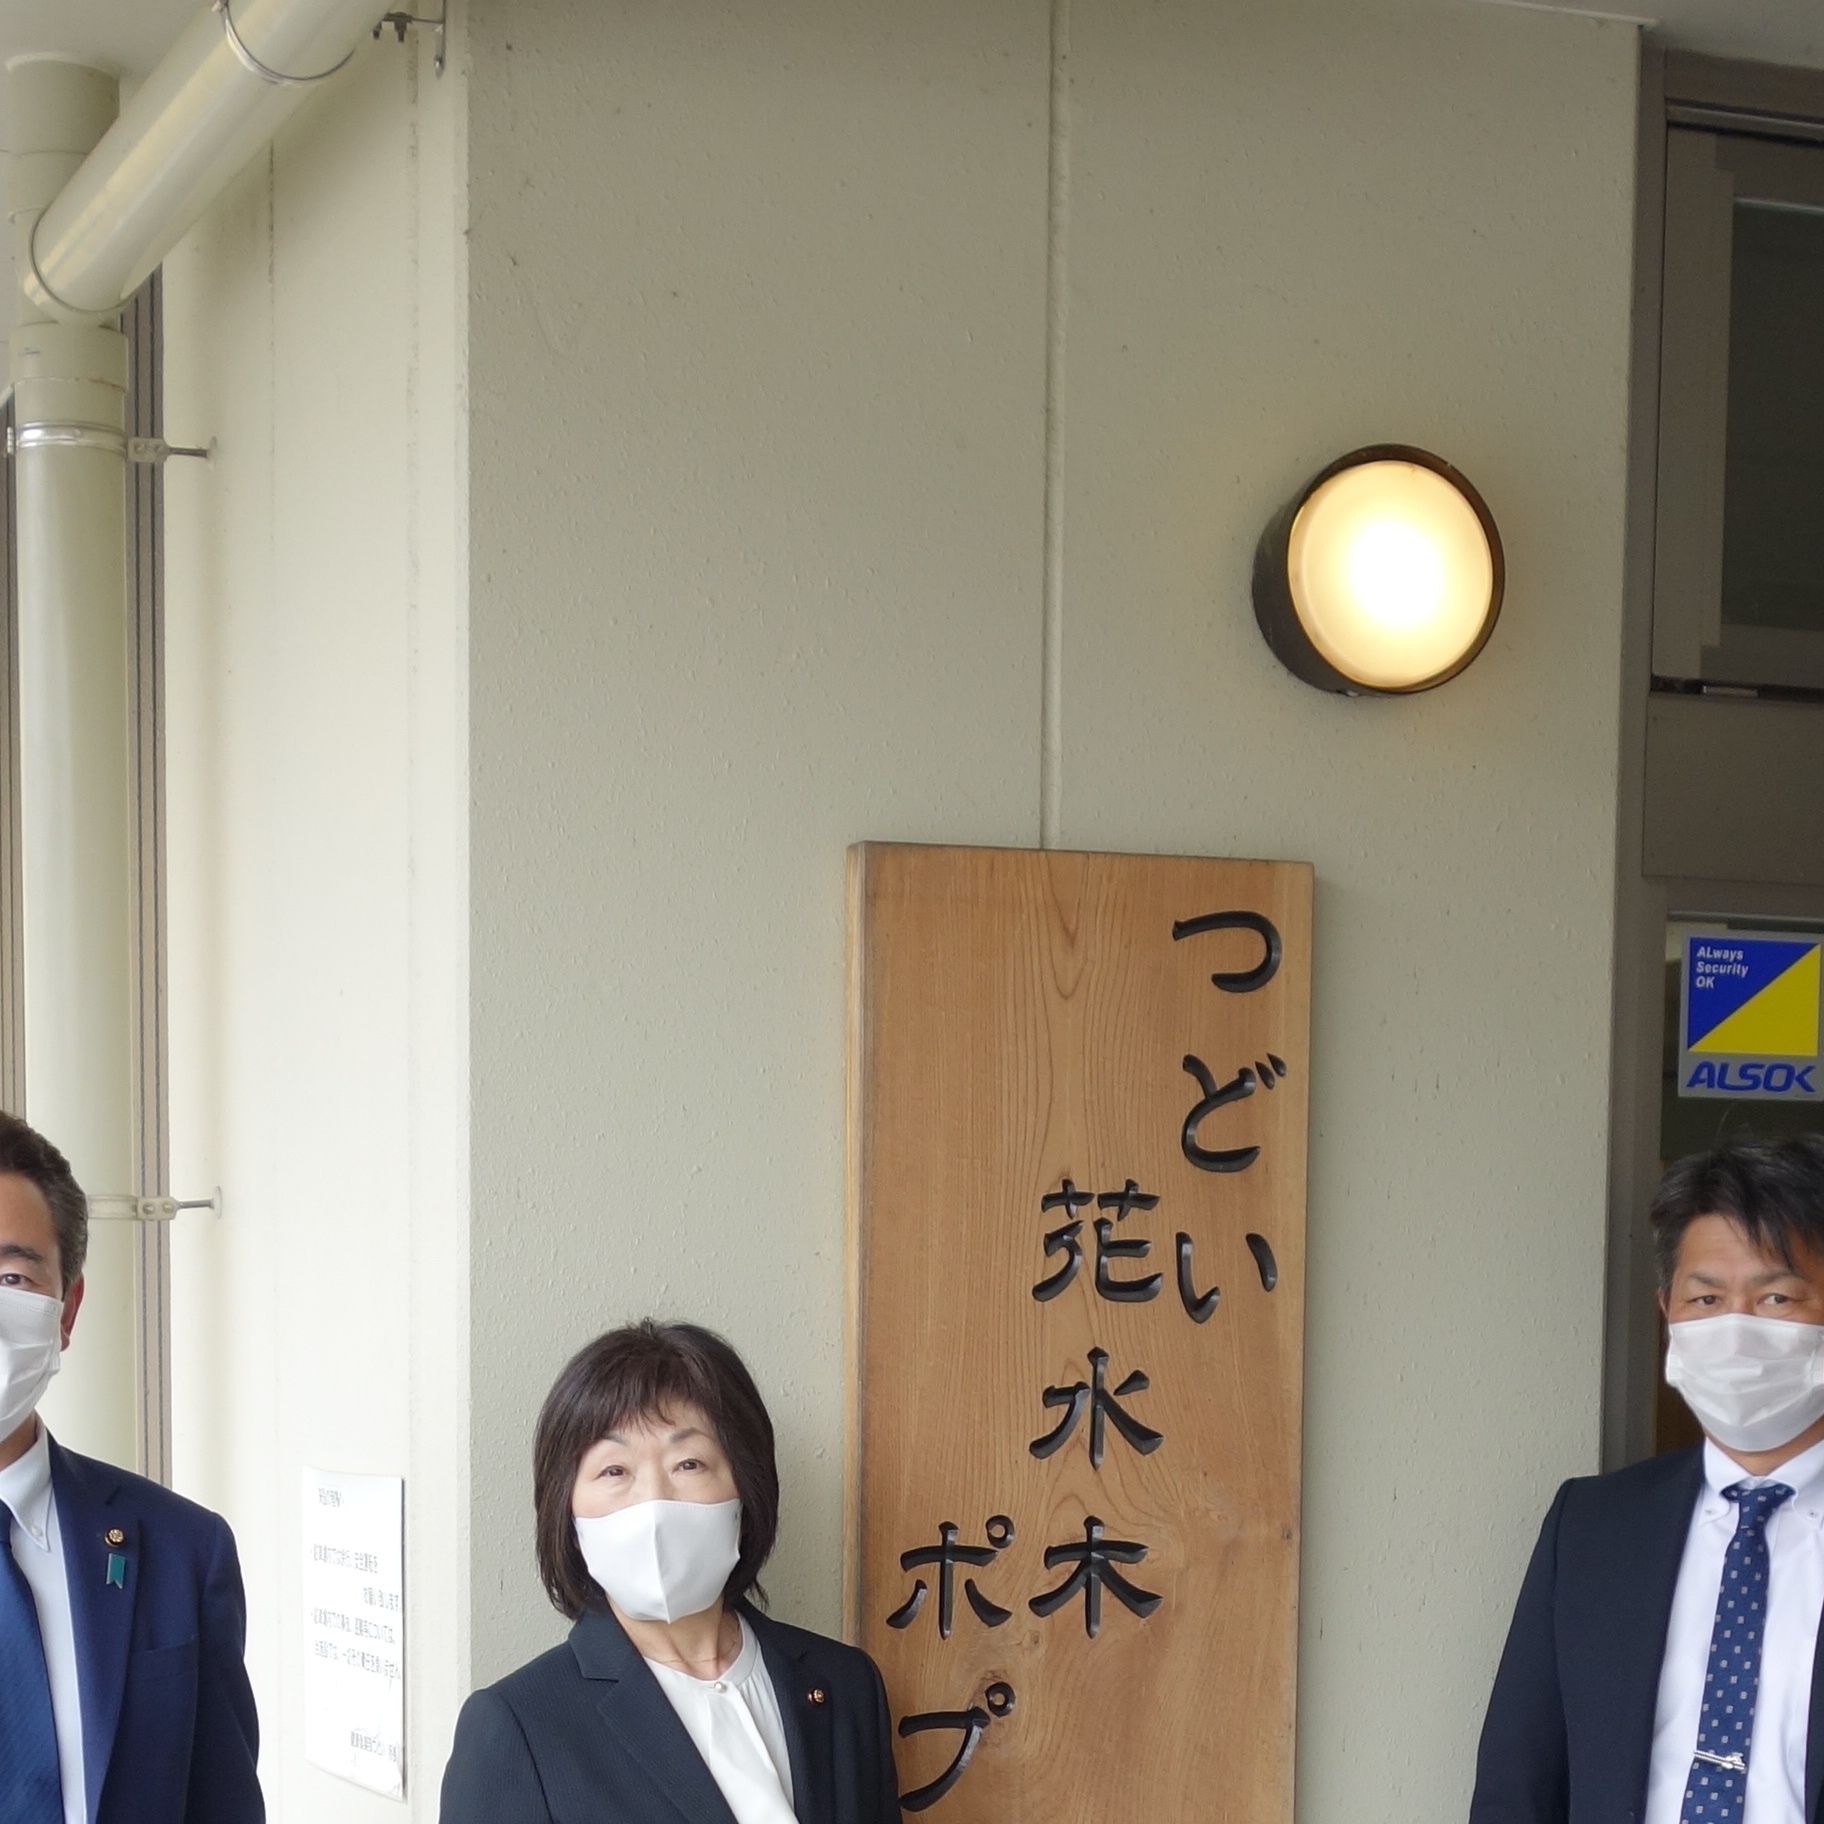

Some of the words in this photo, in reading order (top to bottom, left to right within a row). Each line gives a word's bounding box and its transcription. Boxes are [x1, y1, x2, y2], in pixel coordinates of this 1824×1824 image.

[1697, 947, 1744, 961] ALways
[1696, 962, 1748, 977] Security
[1696, 976, 1715, 988] OK
[1687, 1061, 1816, 1092] ALSOK
[1171, 909, 1288, 1324] つどい
